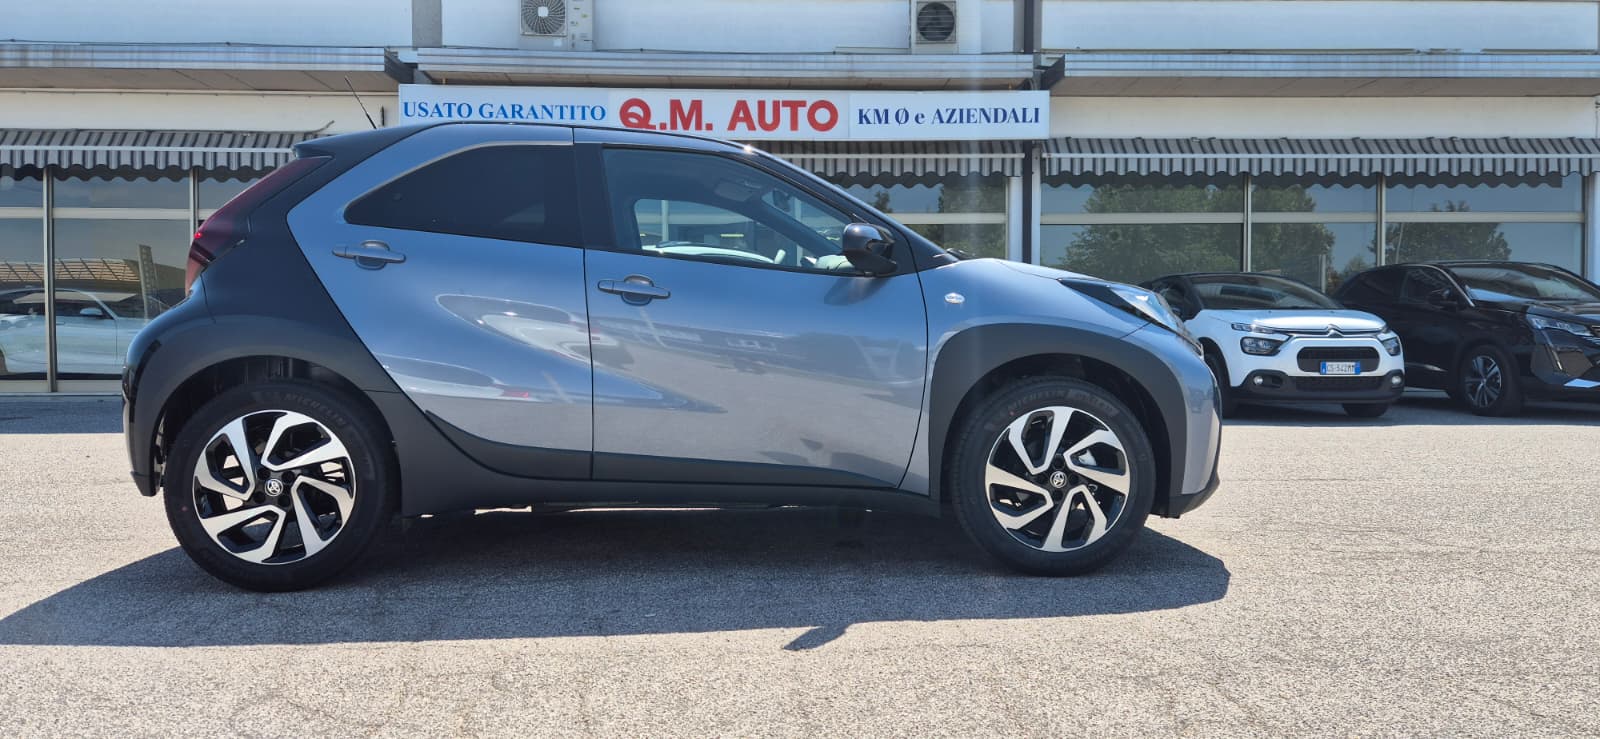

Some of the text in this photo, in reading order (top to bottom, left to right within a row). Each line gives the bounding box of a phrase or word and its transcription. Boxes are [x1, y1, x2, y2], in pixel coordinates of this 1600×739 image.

[403, 101, 606, 121] USATO GARANTITO
[619, 98, 839, 132] Q.M. AUTO
[857, 108, 890, 125] KM
[914, 112, 926, 125] e
[931, 107, 1040, 125] AZIENDALI
